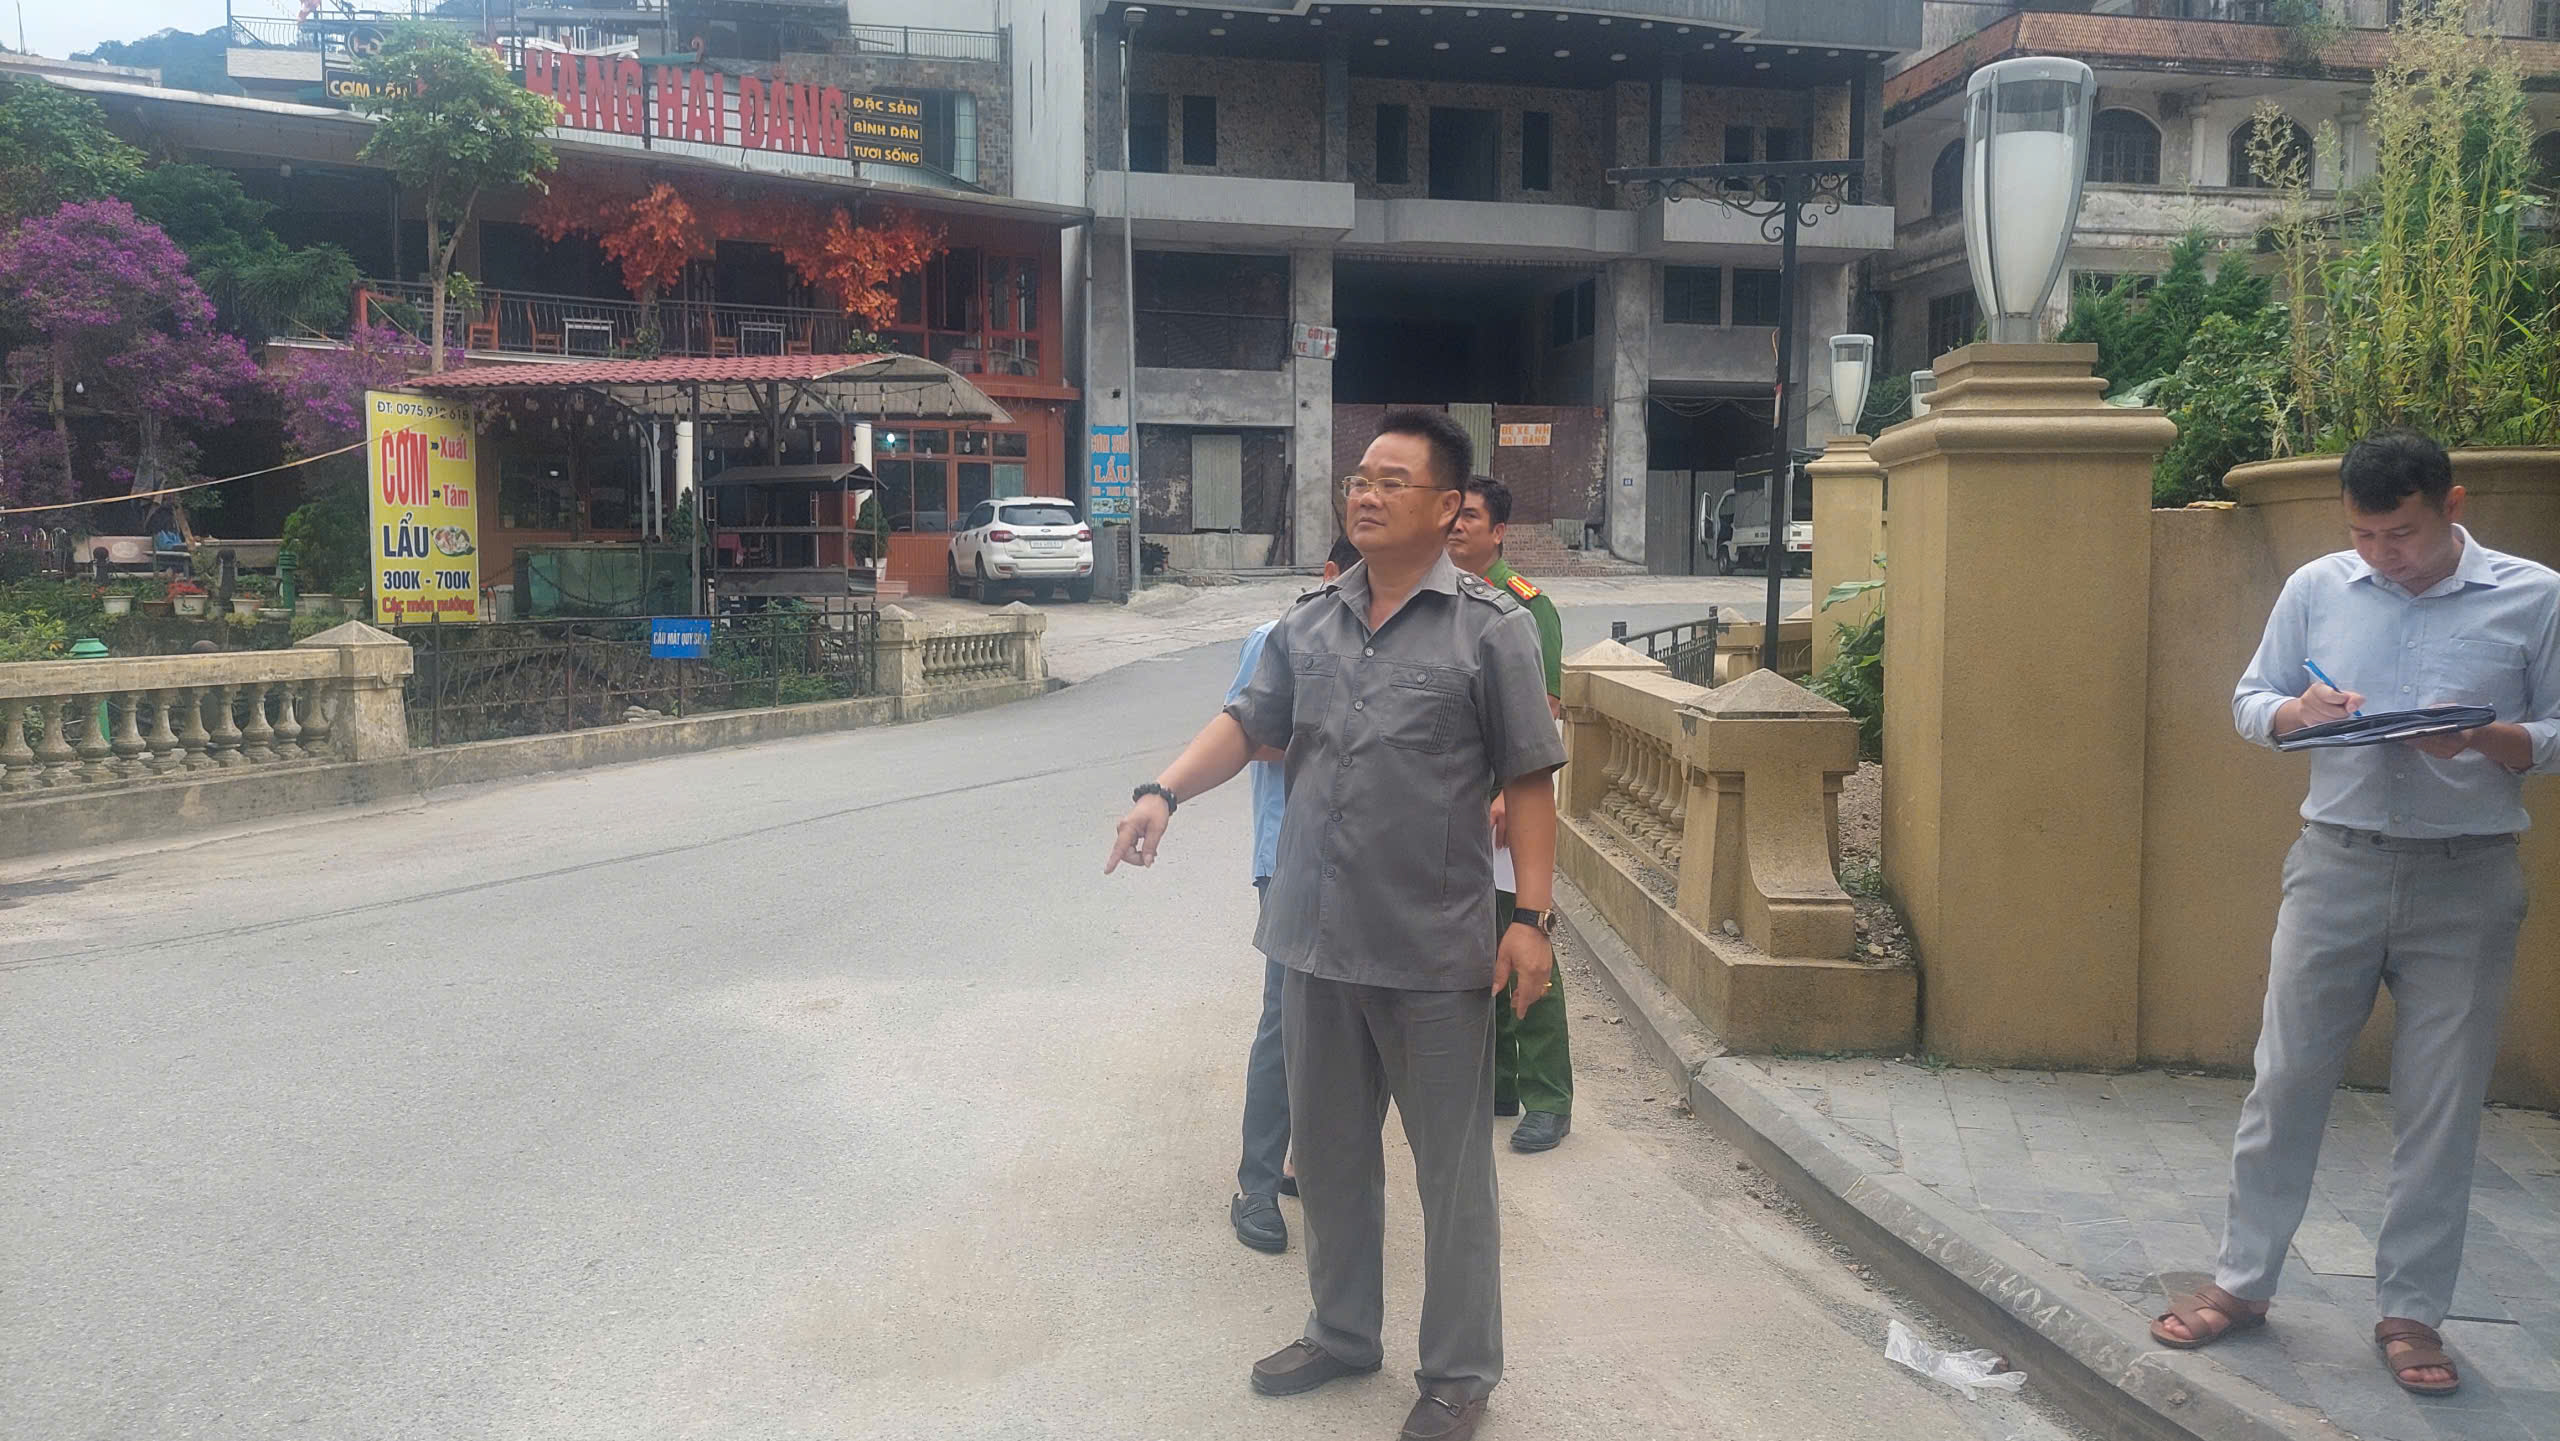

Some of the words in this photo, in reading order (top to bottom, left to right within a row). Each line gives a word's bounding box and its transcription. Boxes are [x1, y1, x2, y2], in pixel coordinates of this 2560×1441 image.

[657, 36, 724, 144] HẢI
[853, 96, 884, 113] ĐẶC
[888, 97, 918, 116] SẢN
[854, 120, 886, 136] BÌNH
[890, 125, 919, 139] DÂN
[853, 145, 882, 159] TƯƠI
[885, 147, 919, 163] SỐNG
[381, 427, 429, 506] CƠM
[440, 432, 468, 460] Xuất
[442, 483, 469, 507] Tám
[383, 511, 429, 558] LẨU
[383, 571, 421, 590] 300K
[435, 571, 471, 590] 700K
